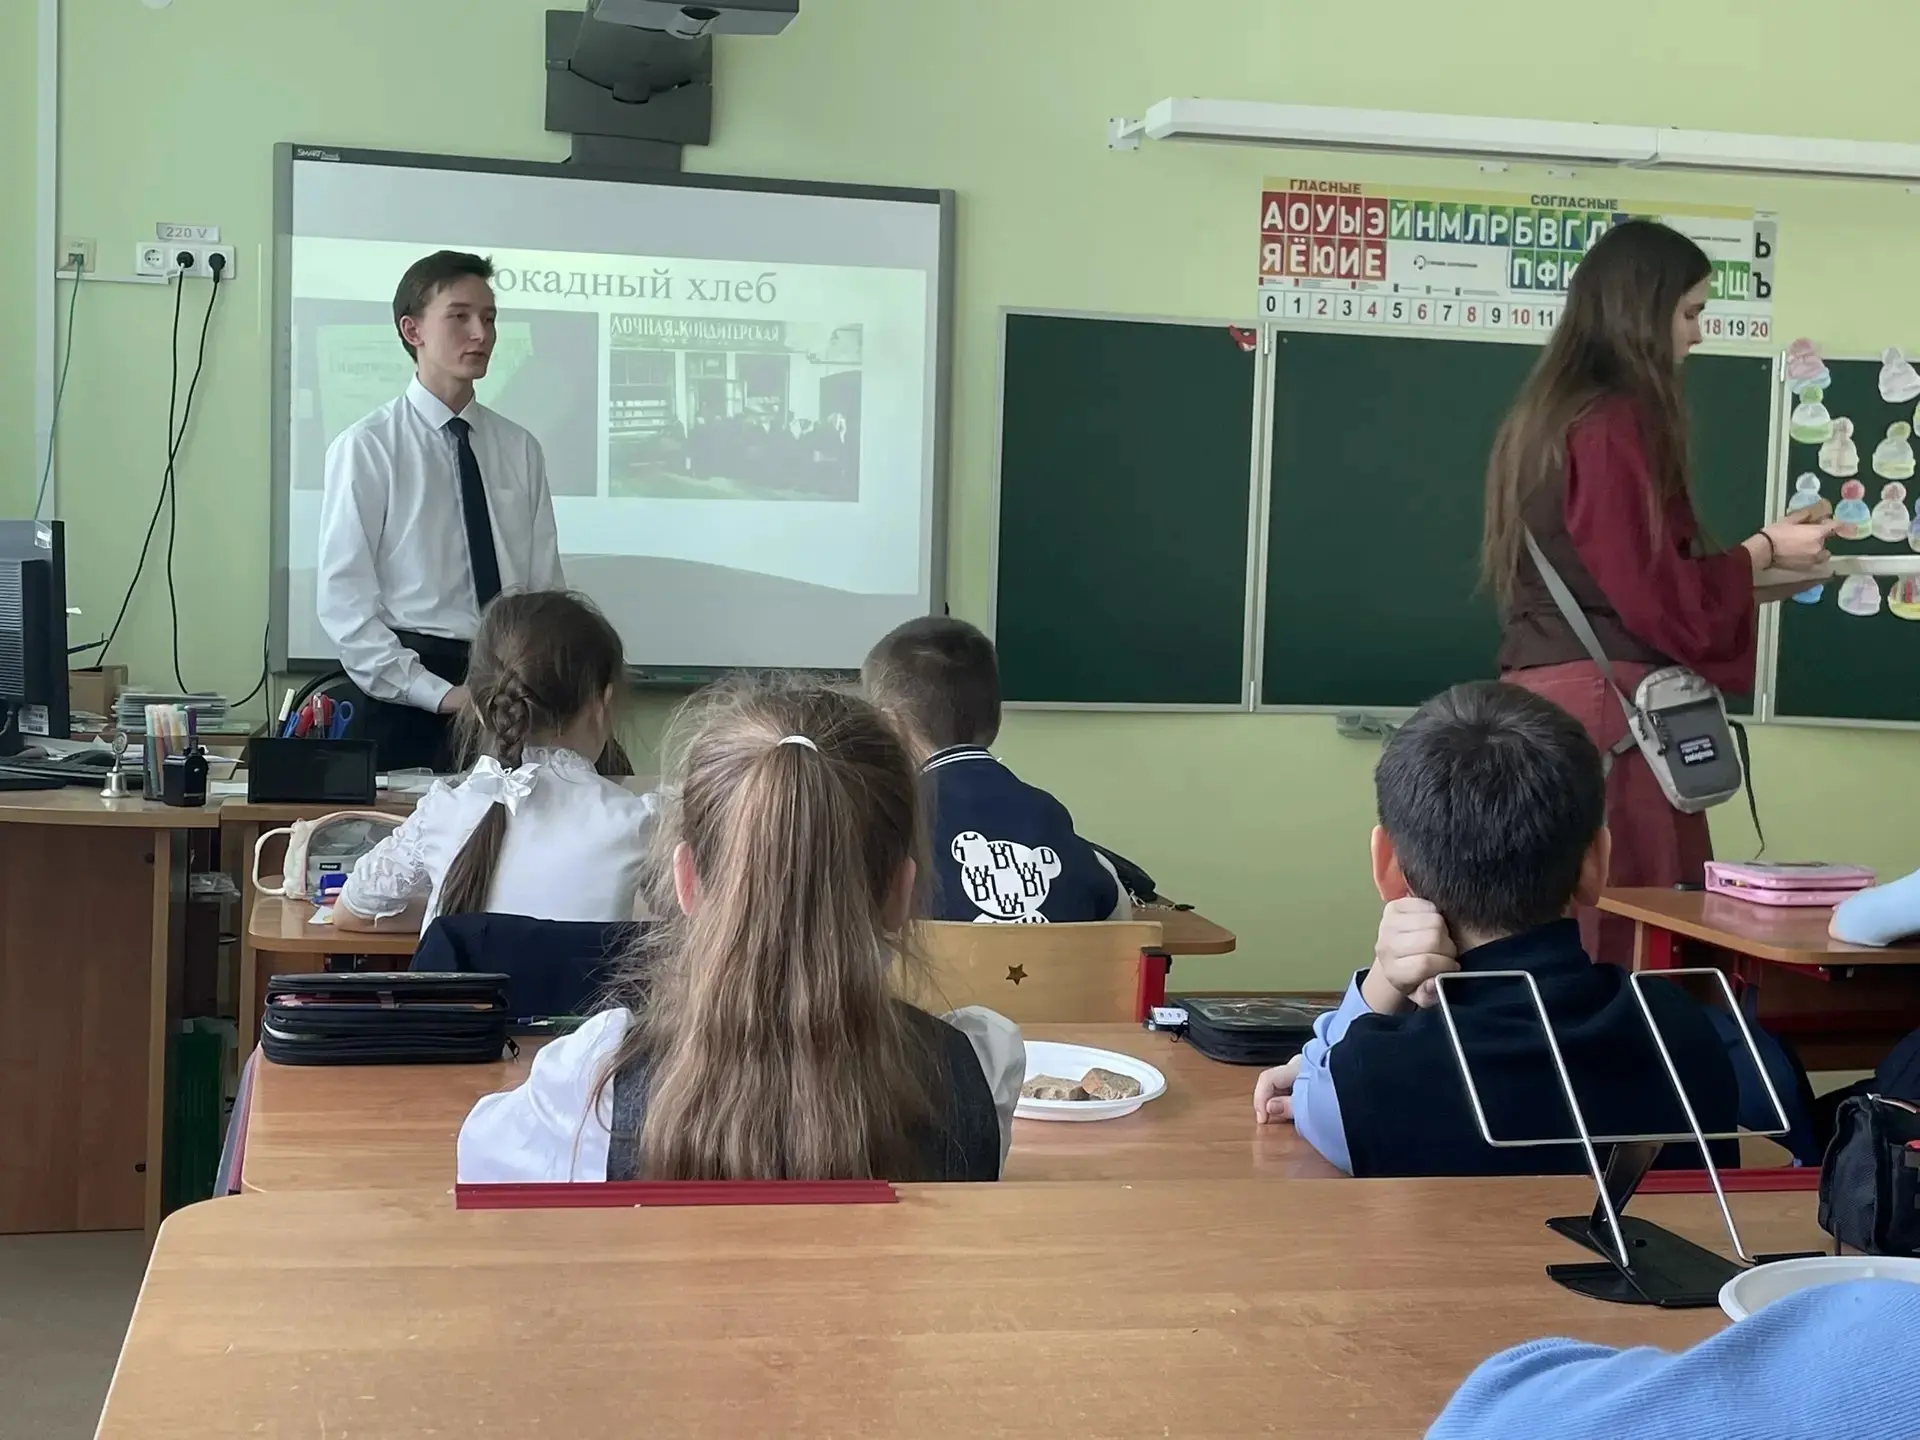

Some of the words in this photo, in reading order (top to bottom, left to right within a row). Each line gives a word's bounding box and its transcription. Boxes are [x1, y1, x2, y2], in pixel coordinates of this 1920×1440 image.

[1289, 179, 1362, 194] ГЛАСНЫЕ
[1530, 194, 1619, 210] СОГЛАСНЫЕ
[166, 226, 192, 238] 220
[196, 228, 208, 238] V
[494, 266, 673, 299] окадный
[686, 272, 778, 304] хлеб
[1266, 296, 1276, 312] 0
[1293, 297, 1301, 313] 1
[1317, 298, 1327, 314] 2
[1342, 300, 1352, 316] 3
[1367, 301, 1377, 317] 4
[1392, 302, 1402, 318] 5
[1417, 303, 1427, 319] 6
[1443, 304, 1453, 321] 7
[1467, 306, 1476, 322] 8
[1491, 307, 1501, 323] 9
[1511, 308, 1530, 325] 10
[1538, 310, 1554, 326] 11
[1704, 319, 1721, 335] 18
[1728, 320, 1745, 336] 19
[1750, 321, 1768, 337] 20
